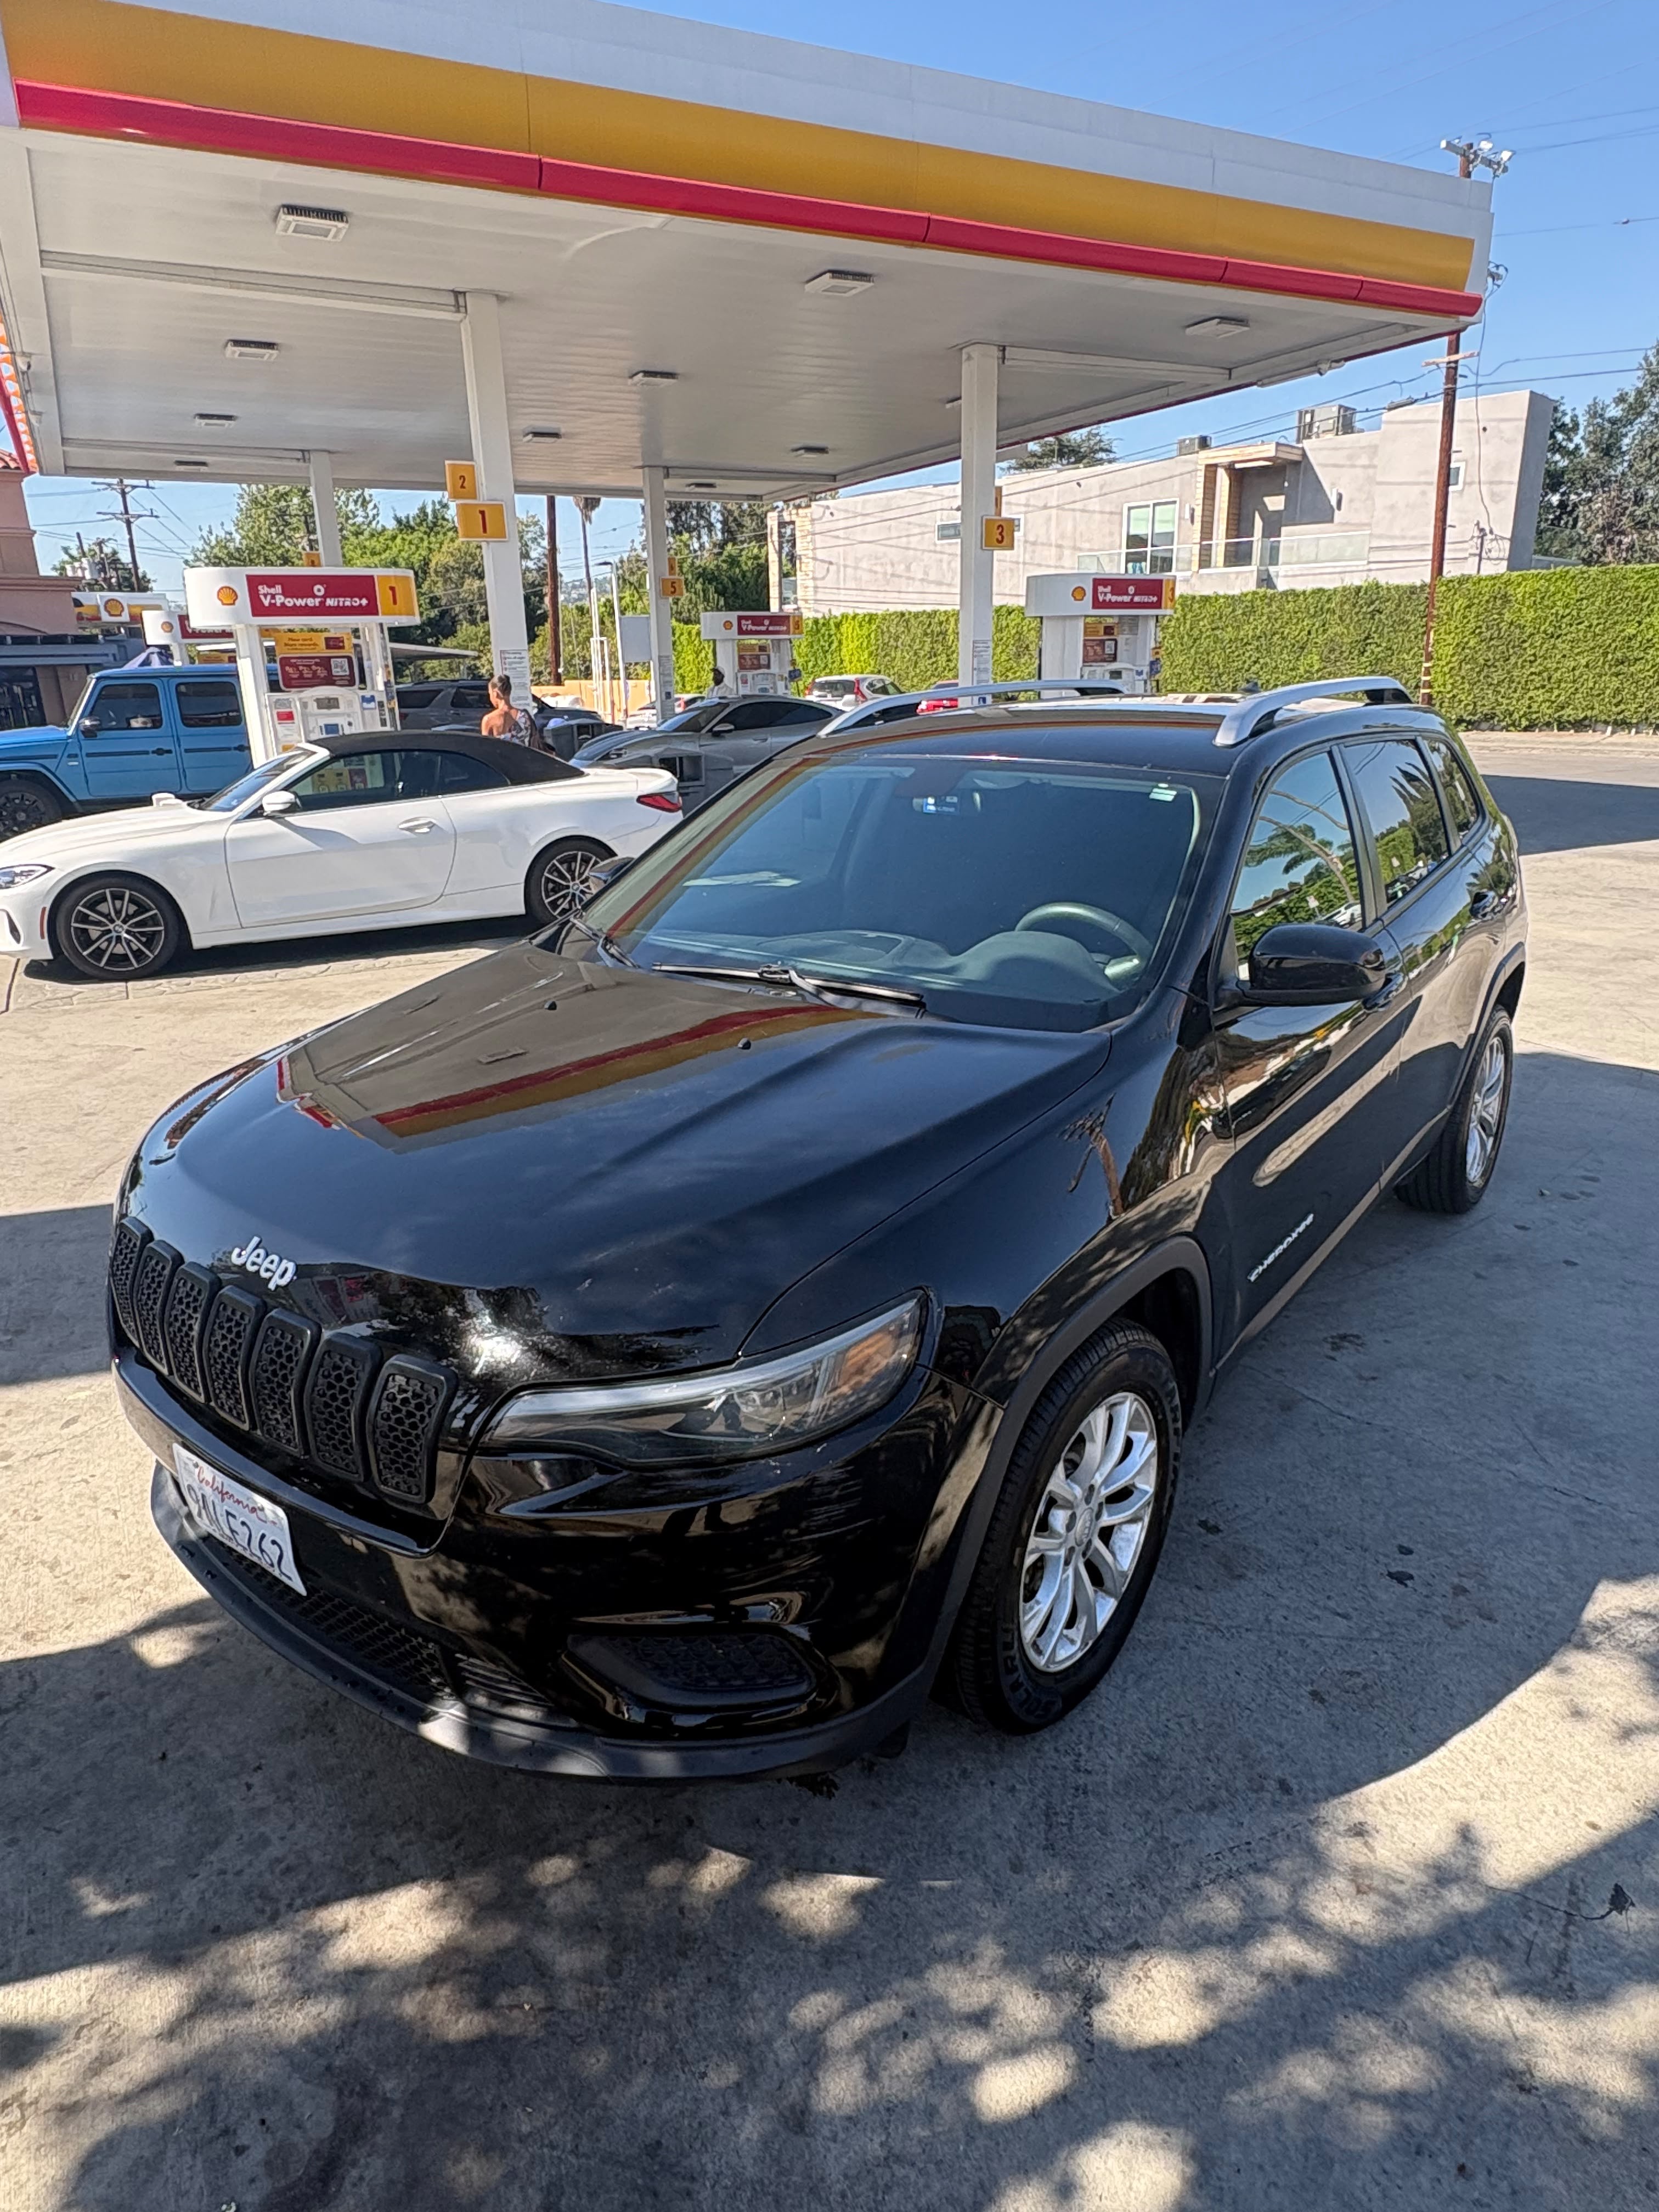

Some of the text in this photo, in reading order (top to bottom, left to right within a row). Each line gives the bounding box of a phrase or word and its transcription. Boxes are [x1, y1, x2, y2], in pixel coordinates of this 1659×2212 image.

[459, 475, 466, 489] 2
[478, 509, 487, 534] 1
[996, 524, 1005, 544] 3
[258, 584, 282, 594] Shell
[389, 585, 397, 606] 1
[670, 581, 676, 595] 5
[1169, 587, 1174, 602] 3
[259, 594, 320, 607] V-Power
[1098, 593, 1132, 602] V-Power
[231, 1235, 296, 1291] Jeep
[197, 1465, 277, 1525] California
